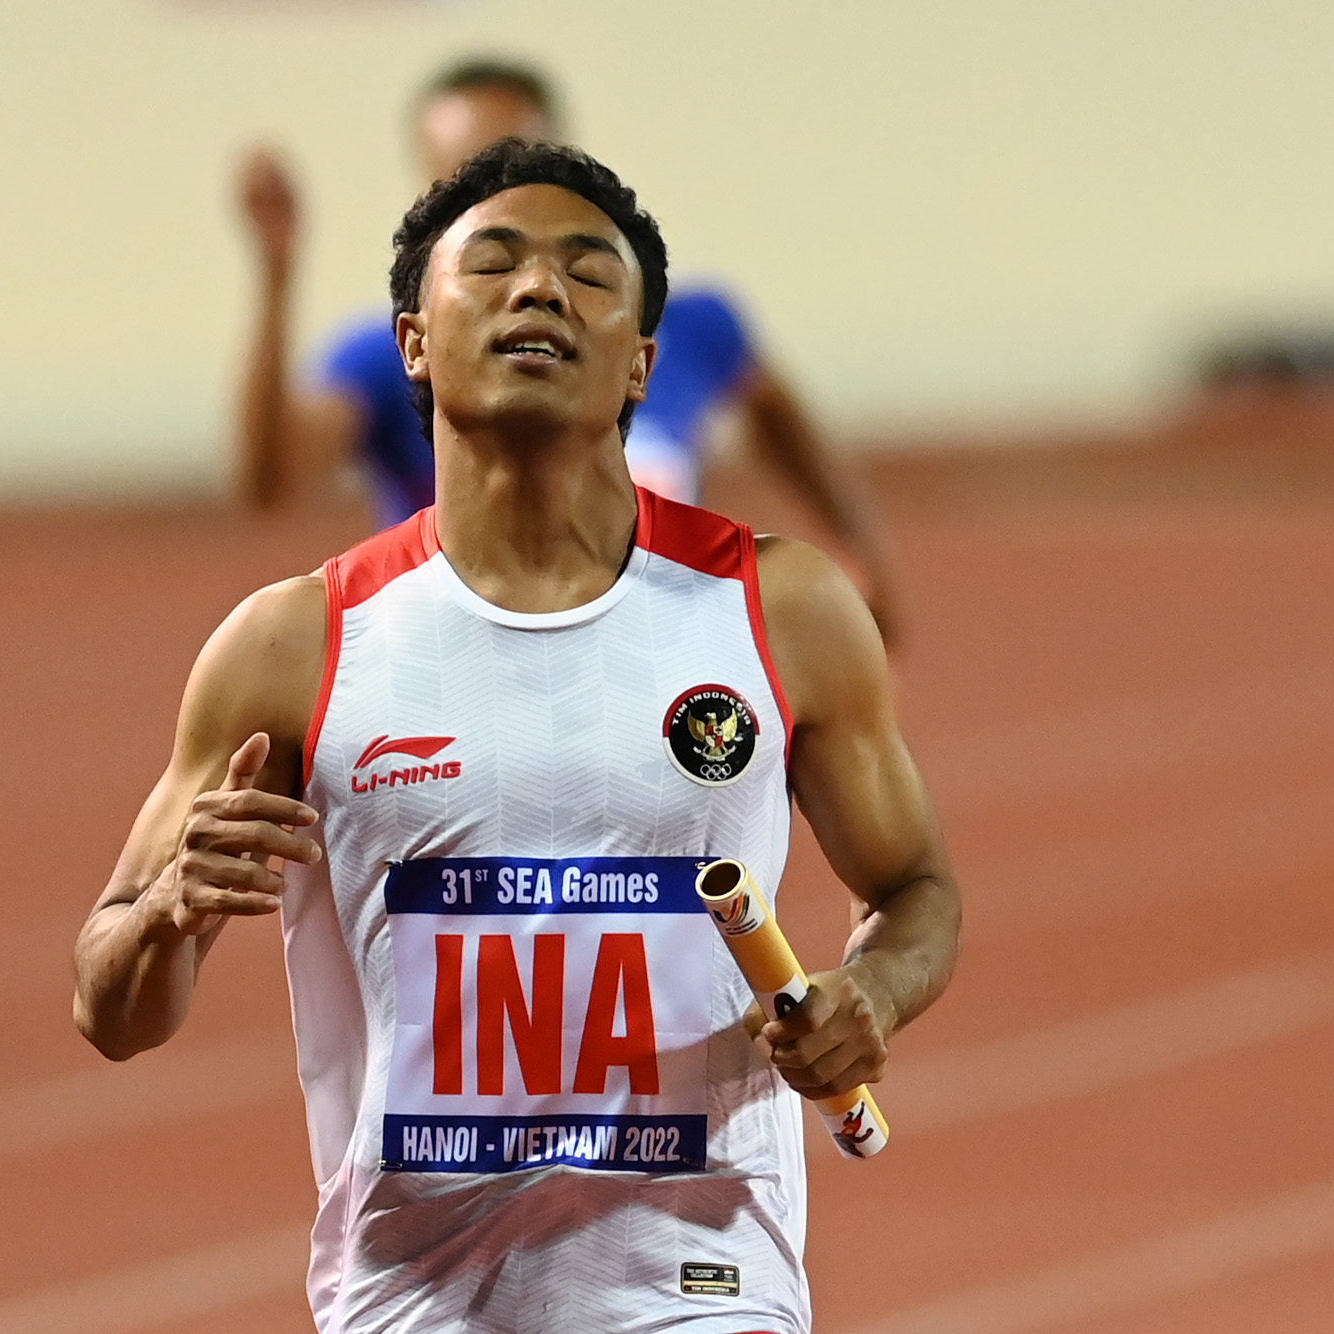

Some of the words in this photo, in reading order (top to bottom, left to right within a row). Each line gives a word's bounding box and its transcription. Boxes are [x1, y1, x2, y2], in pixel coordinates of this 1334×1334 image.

[672, 702, 688, 726] TIM
[351, 761, 461, 792] LI-NING
[497, 867, 553, 905] SEA
[562, 867, 659, 904] Games
[433, 933, 660, 1096] INA
[402, 1126, 478, 1162] HANOI
[503, 1125, 618, 1163] VIETNAM
[623, 1127, 681, 1163] 2022
